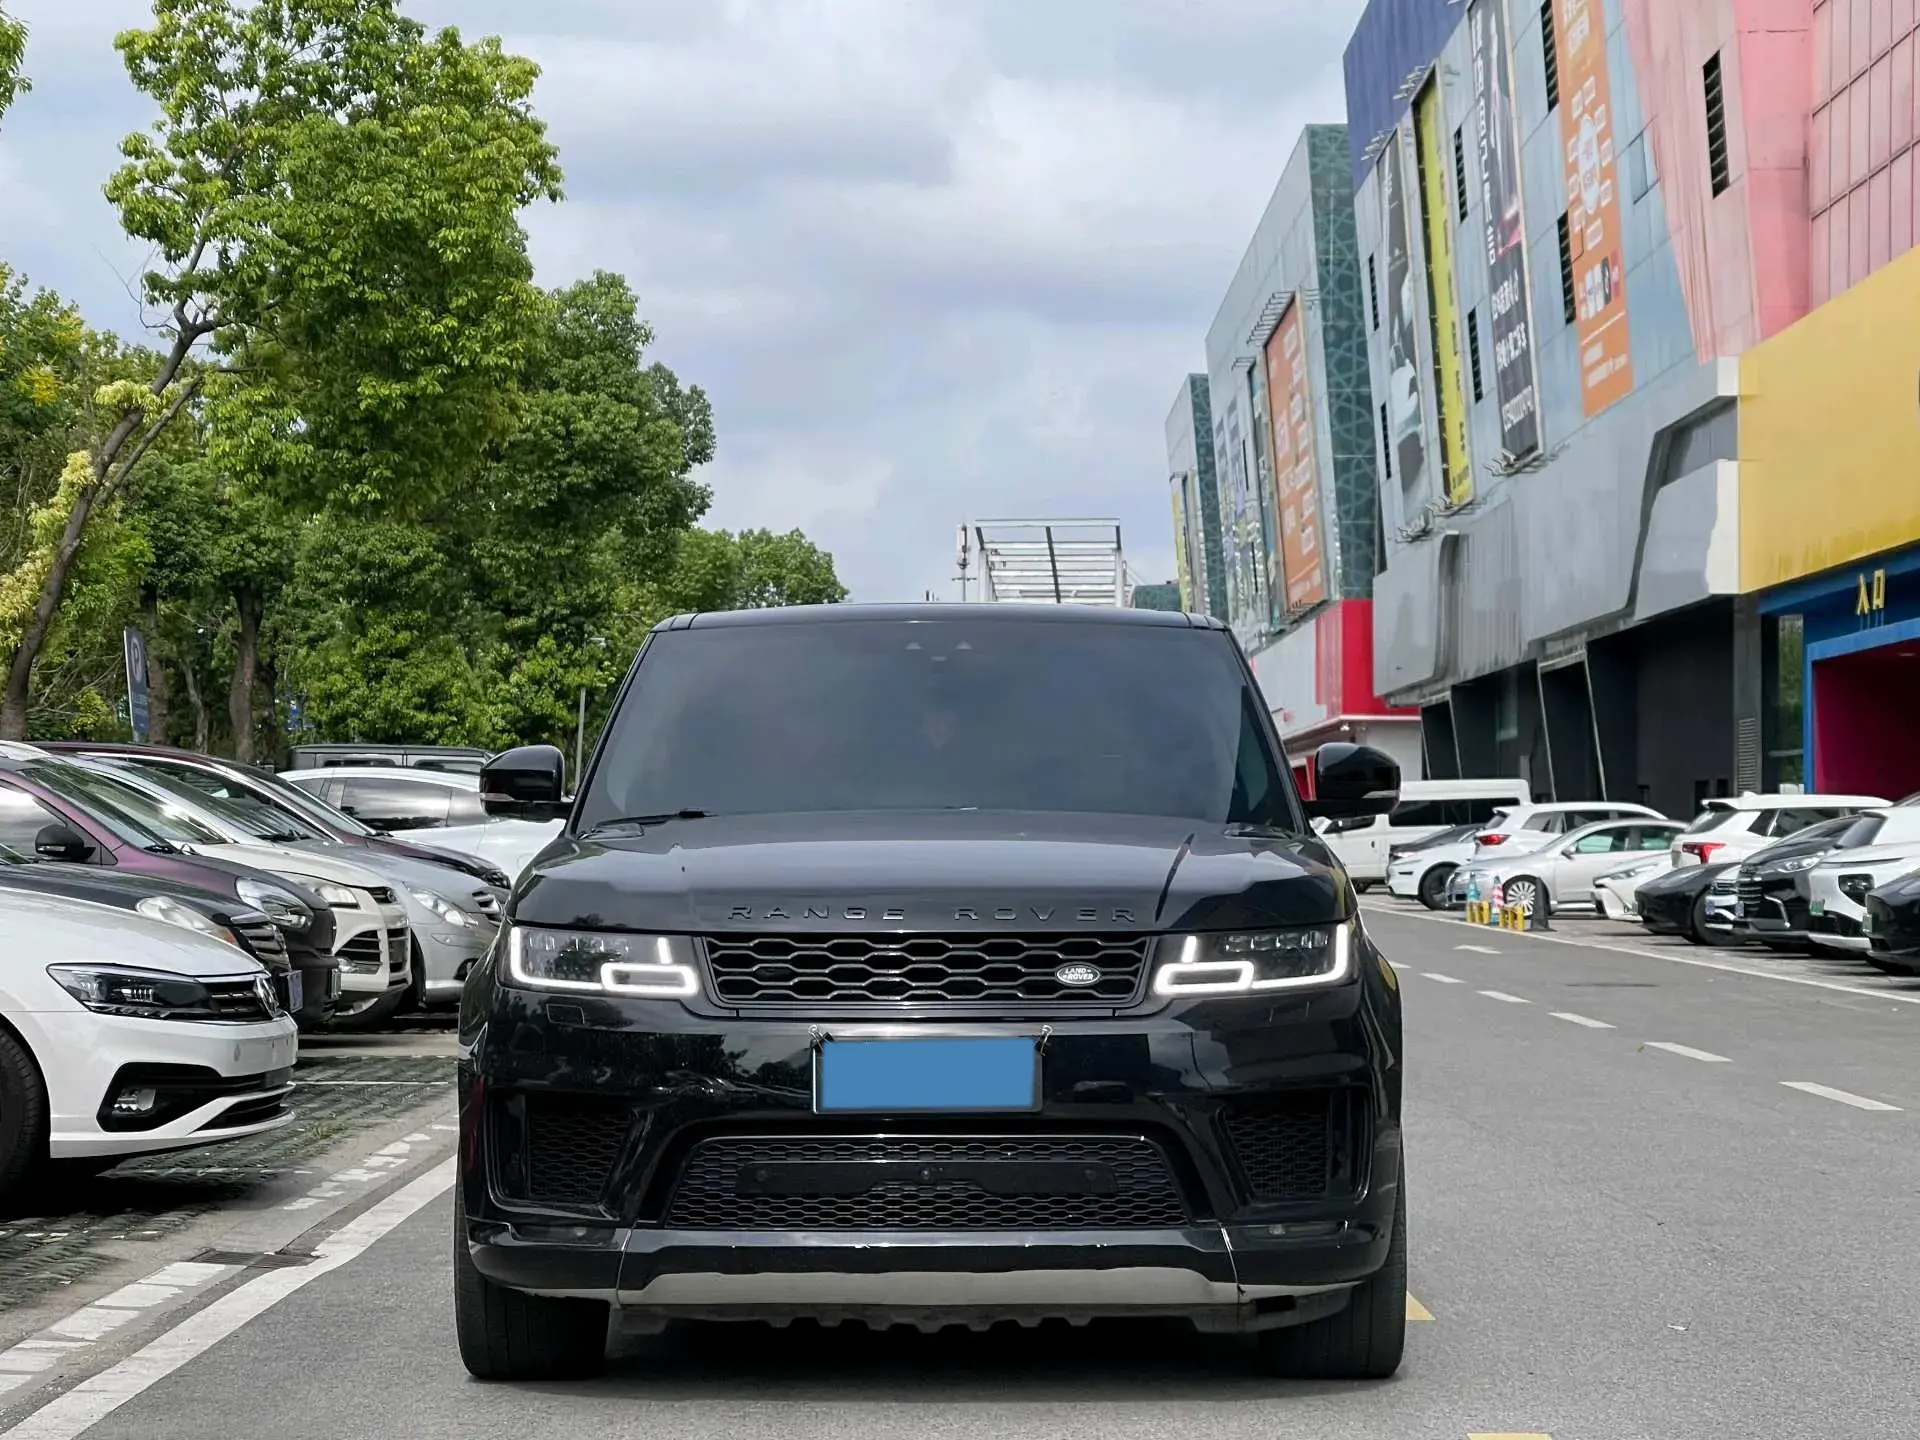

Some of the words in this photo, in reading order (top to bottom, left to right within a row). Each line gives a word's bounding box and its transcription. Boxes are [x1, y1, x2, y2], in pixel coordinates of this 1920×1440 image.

[1857, 568, 1885, 616] 入口
[728, 906, 905, 920] RANGE
[953, 906, 1136, 923] ROVER
[1067, 973, 1094, 981] ROVER
